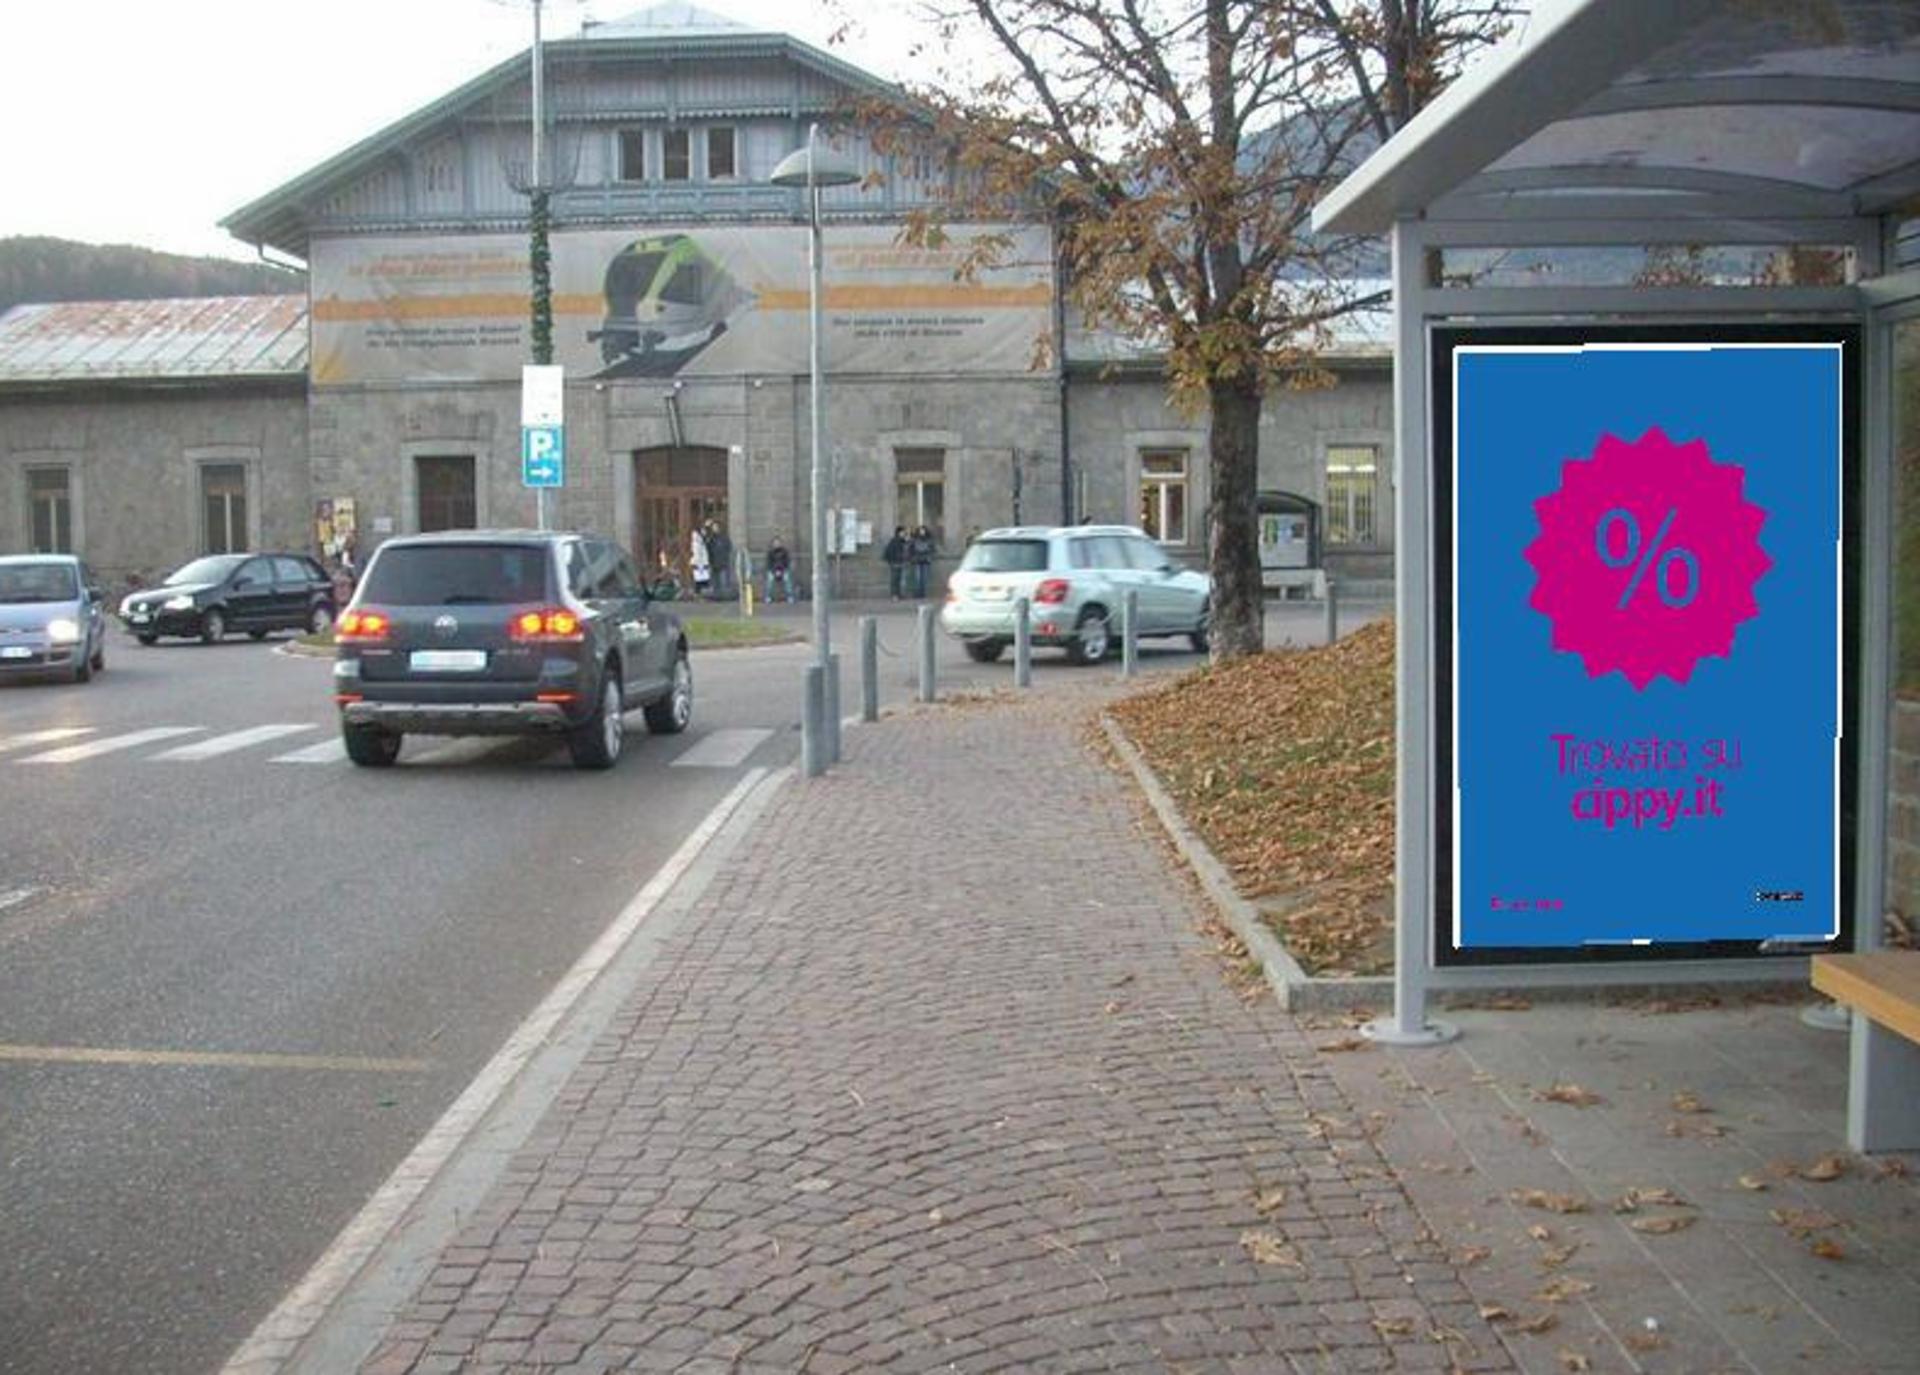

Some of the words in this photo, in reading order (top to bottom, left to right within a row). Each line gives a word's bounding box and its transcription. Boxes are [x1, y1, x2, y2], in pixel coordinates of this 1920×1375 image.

[530, 431, 552, 461] P
[1595, 506, 1700, 609] %
[1550, 733, 1688, 775] Trovato
[1702, 738, 1743, 771] su
[1571, 775, 1725, 831] cippy.it
